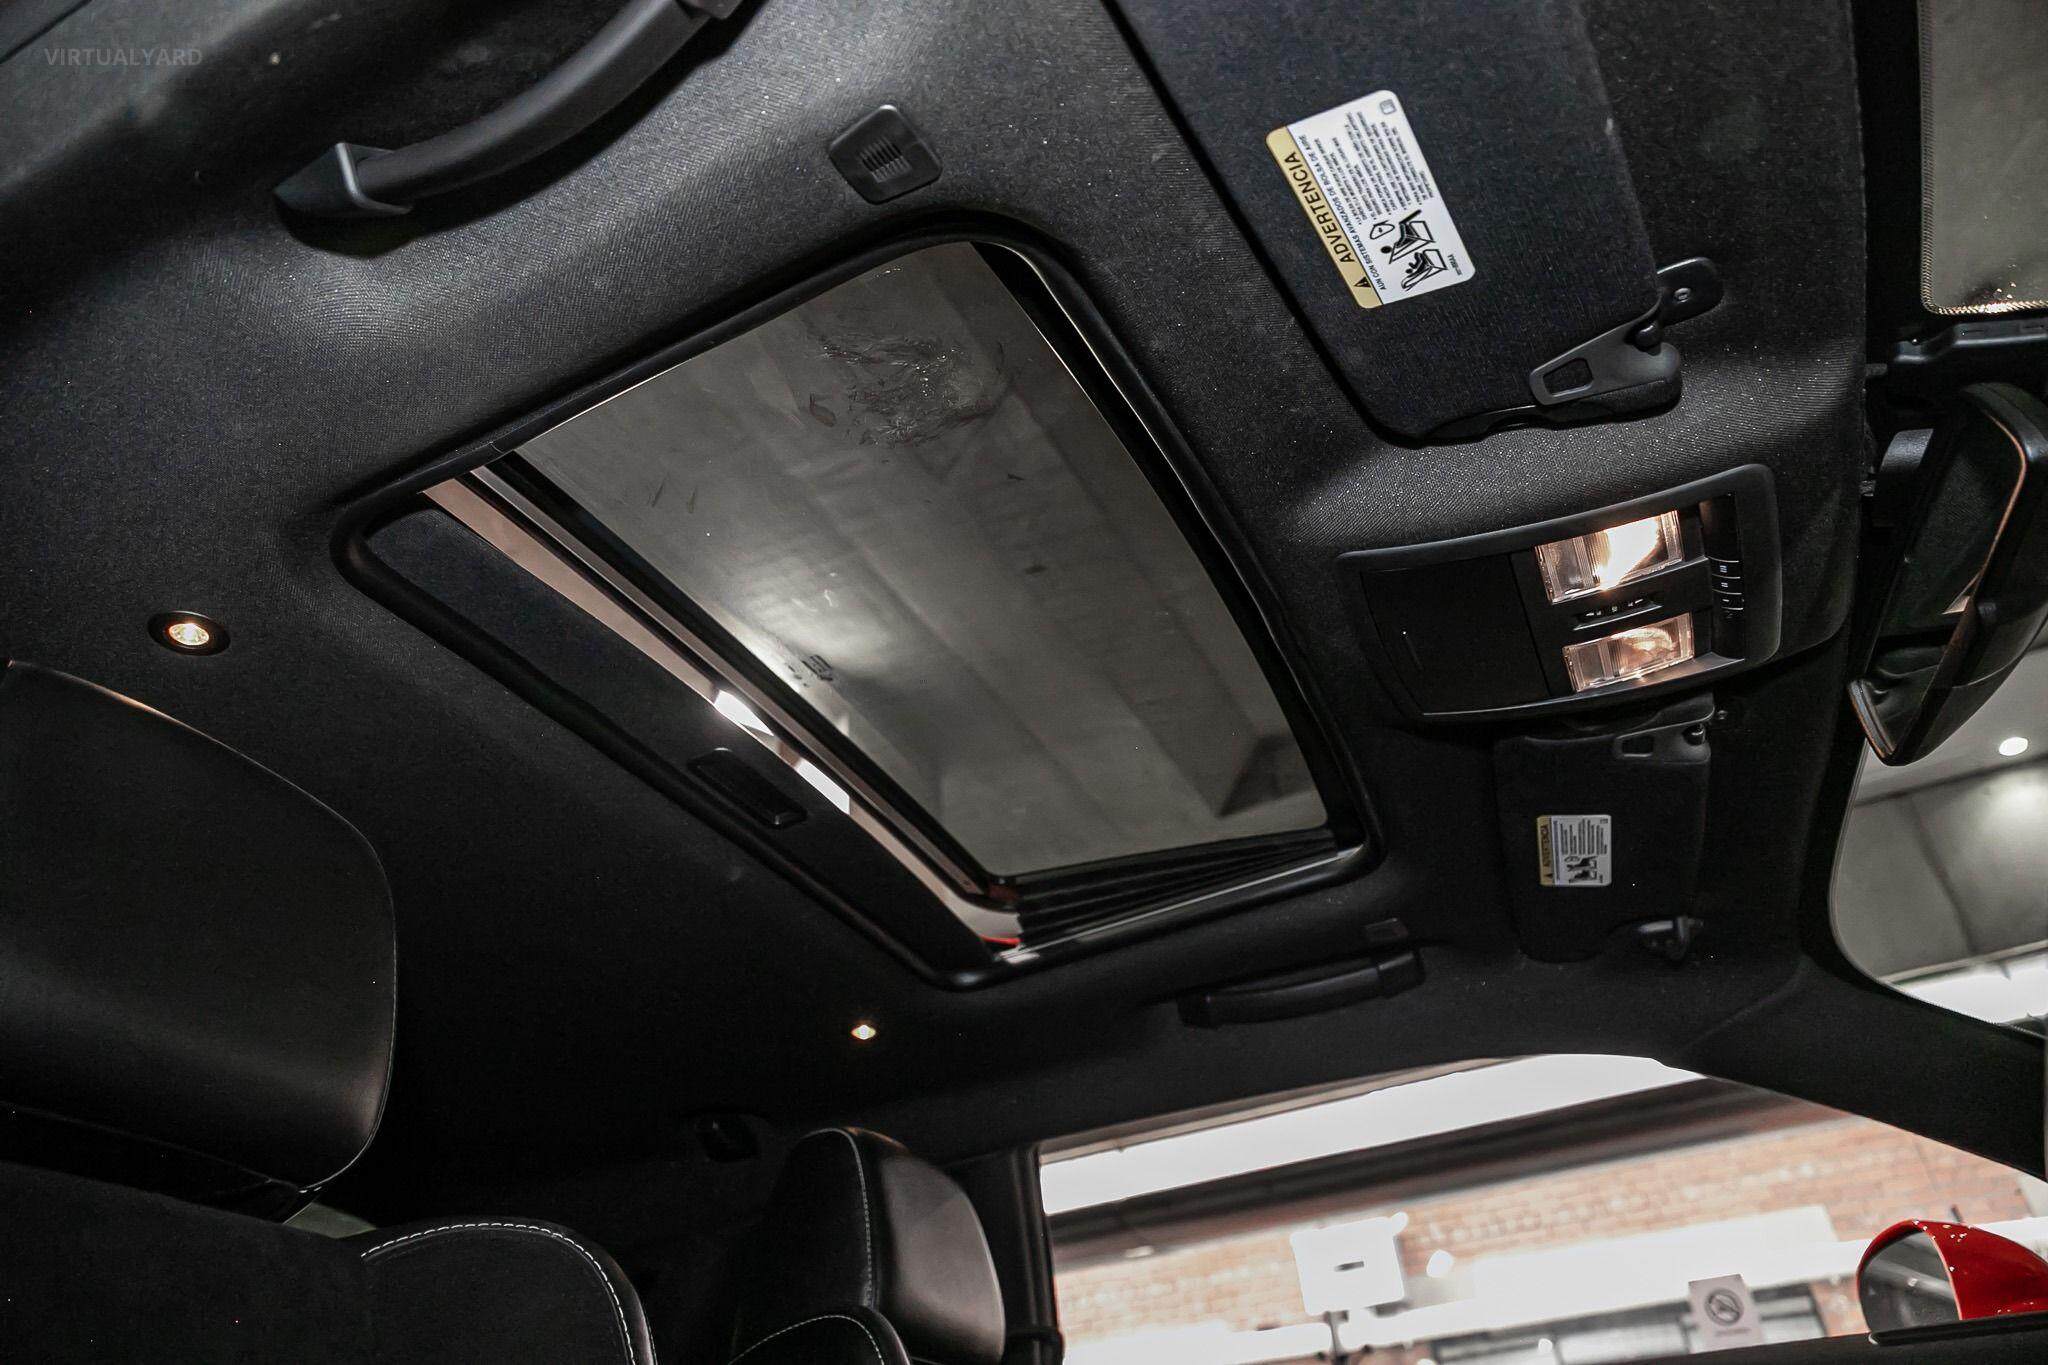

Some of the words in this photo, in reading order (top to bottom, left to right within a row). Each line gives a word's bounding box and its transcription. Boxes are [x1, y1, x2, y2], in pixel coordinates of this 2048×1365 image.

[1307, 151, 1318, 162] DE
[1312, 161, 1331, 186] BOLSA
[1325, 185, 1336, 196] DE
[1283, 151, 1355, 263] ADVERTENCIA
[1331, 196, 1357, 234] AVANZADOS
[1351, 234, 1373, 264] SISTEMAS
[1367, 263, 1380, 278] CON
